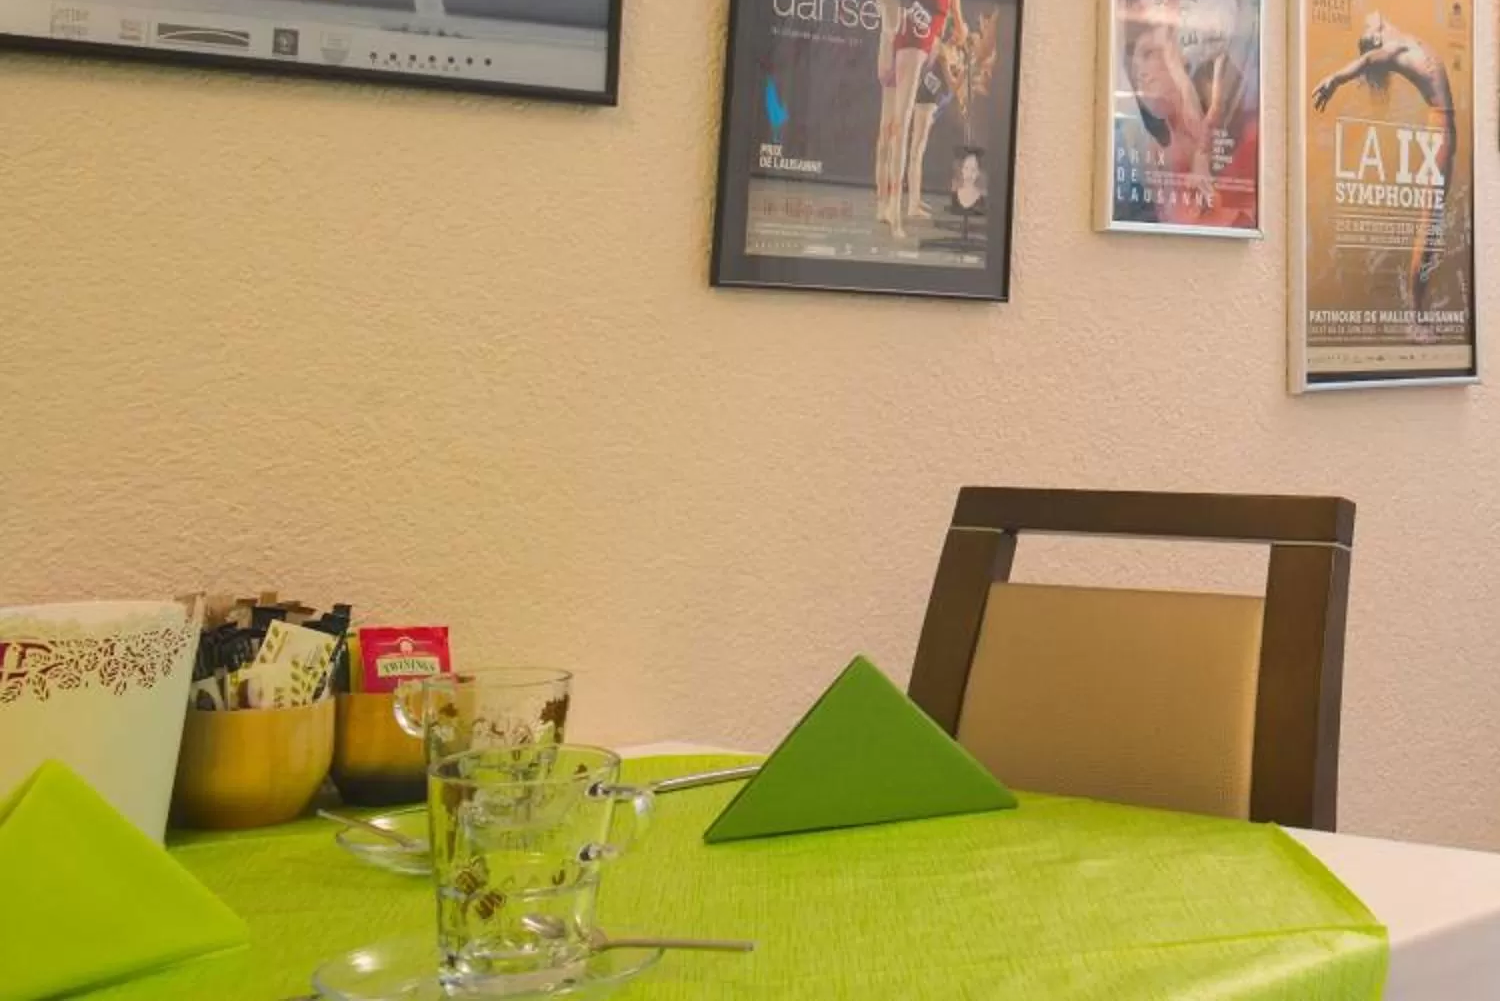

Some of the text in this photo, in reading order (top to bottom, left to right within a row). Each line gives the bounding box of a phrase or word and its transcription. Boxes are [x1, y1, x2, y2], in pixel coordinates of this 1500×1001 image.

[1117, 146, 1165, 166] PRIX
[1336, 118, 1445, 186] LA IX
[1117, 166, 1137, 182] DE
[1117, 186, 1214, 208] LAUSANNE
[1335, 182, 1445, 211] SYMPHONIE
[1309, 310, 1362, 324] PATINOIRE
[382, 658, 436, 674] TWININGS
